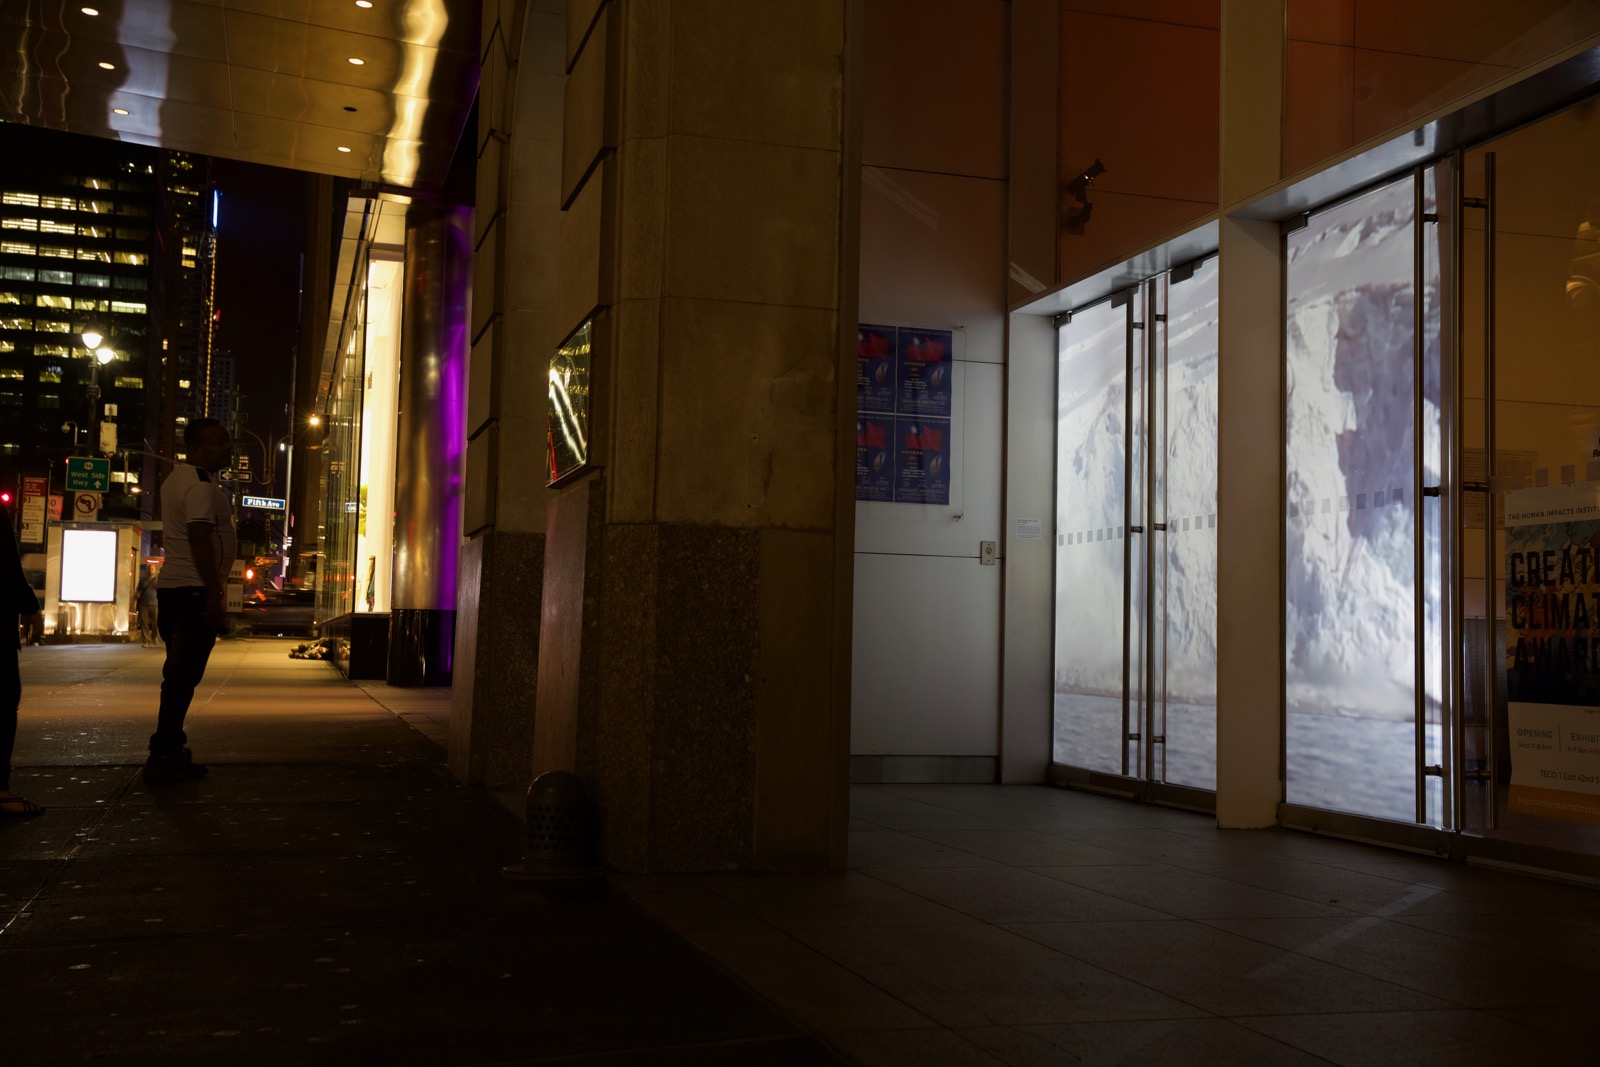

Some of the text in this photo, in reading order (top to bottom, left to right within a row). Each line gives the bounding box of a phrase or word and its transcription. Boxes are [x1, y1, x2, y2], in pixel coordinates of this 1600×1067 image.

[71, 471, 88, 479] West
[73, 479, 88, 487] Hwy
[247, 498, 280, 508] Fifth Ave
[1521, 511, 1545, 519] HUMAN
[1546, 508, 1574, 517] IMPACTS
[1517, 728, 1553, 739] OPENING
[1518, 741, 1530, 749] Sept
[1541, 743, 1553, 751] 6pm
[1563, 772, 1577, 781] East
[1577, 774, 1594, 783] 42nd
